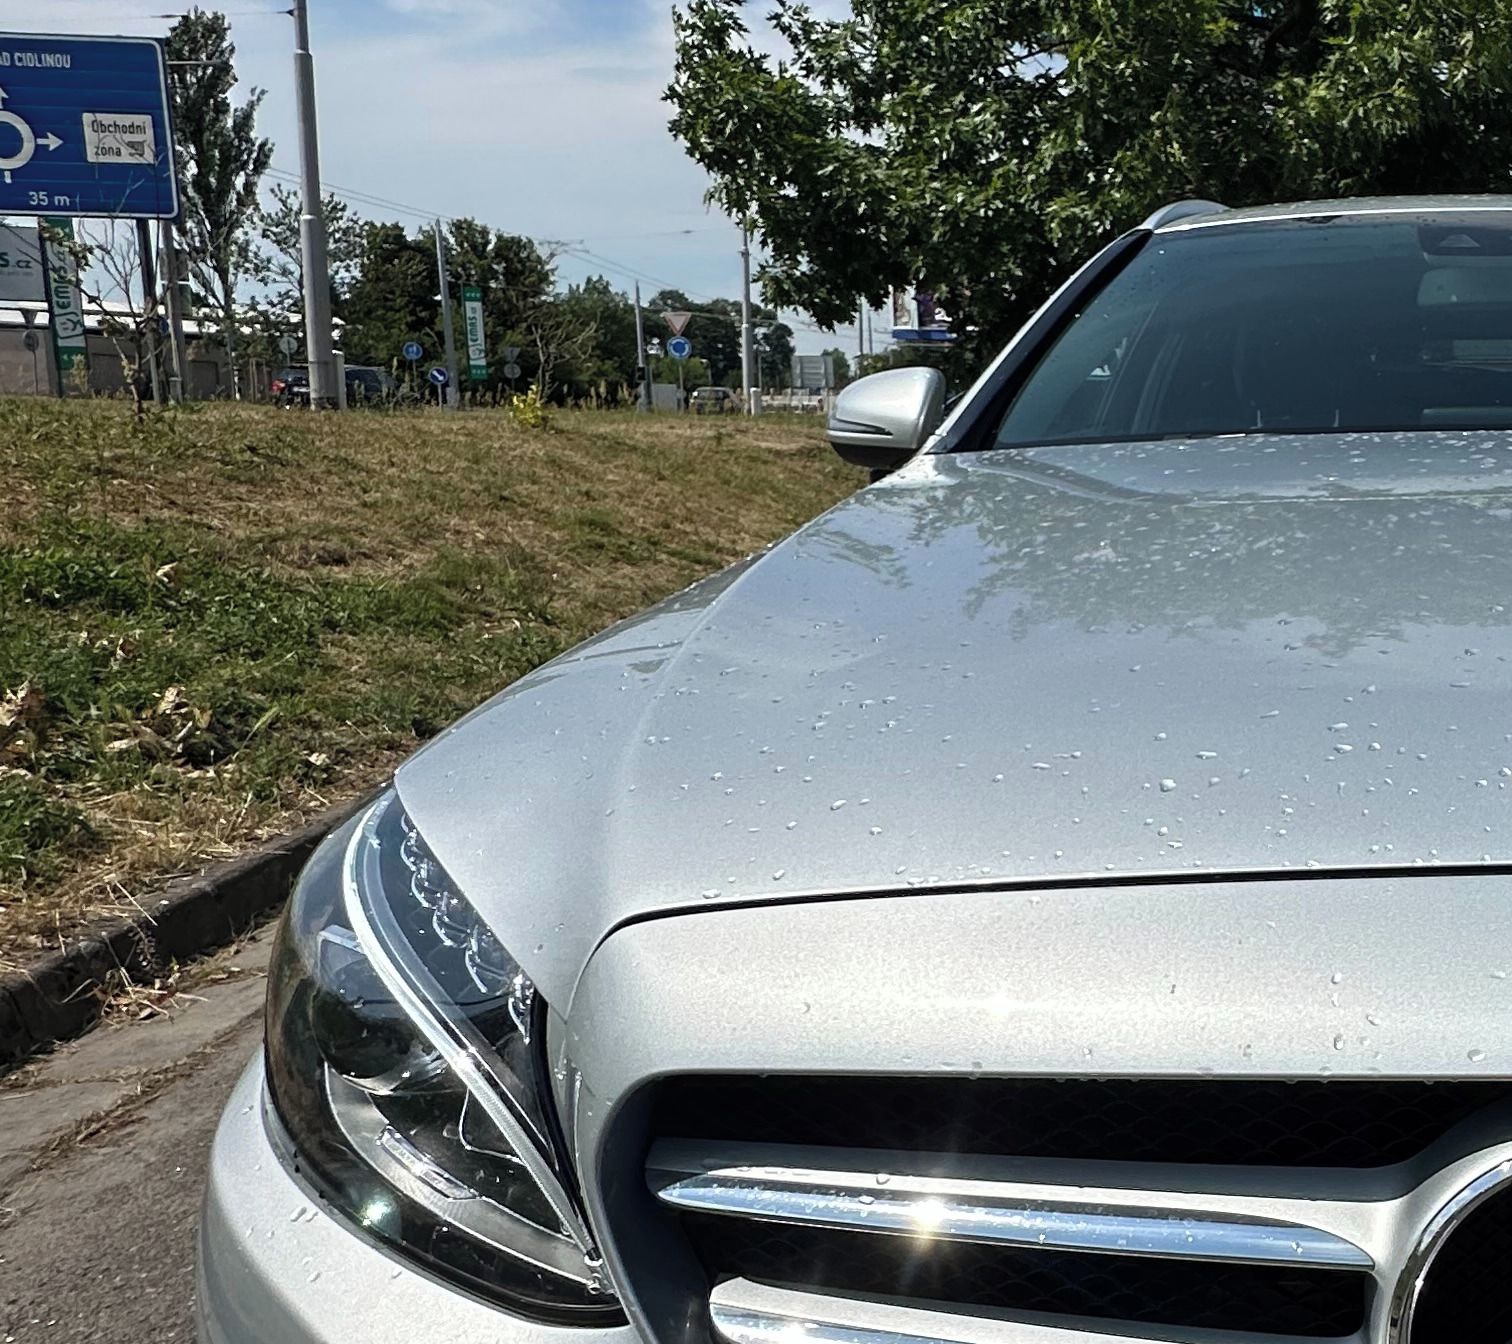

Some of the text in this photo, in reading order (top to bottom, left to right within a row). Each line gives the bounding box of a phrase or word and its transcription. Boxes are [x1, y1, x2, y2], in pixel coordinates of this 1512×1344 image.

[14, 52, 71, 68] CIDLINOU
[91, 120, 147, 135] Obchodní
[94, 142, 122, 157] zóna
[28, 191, 70, 206] 35 m
